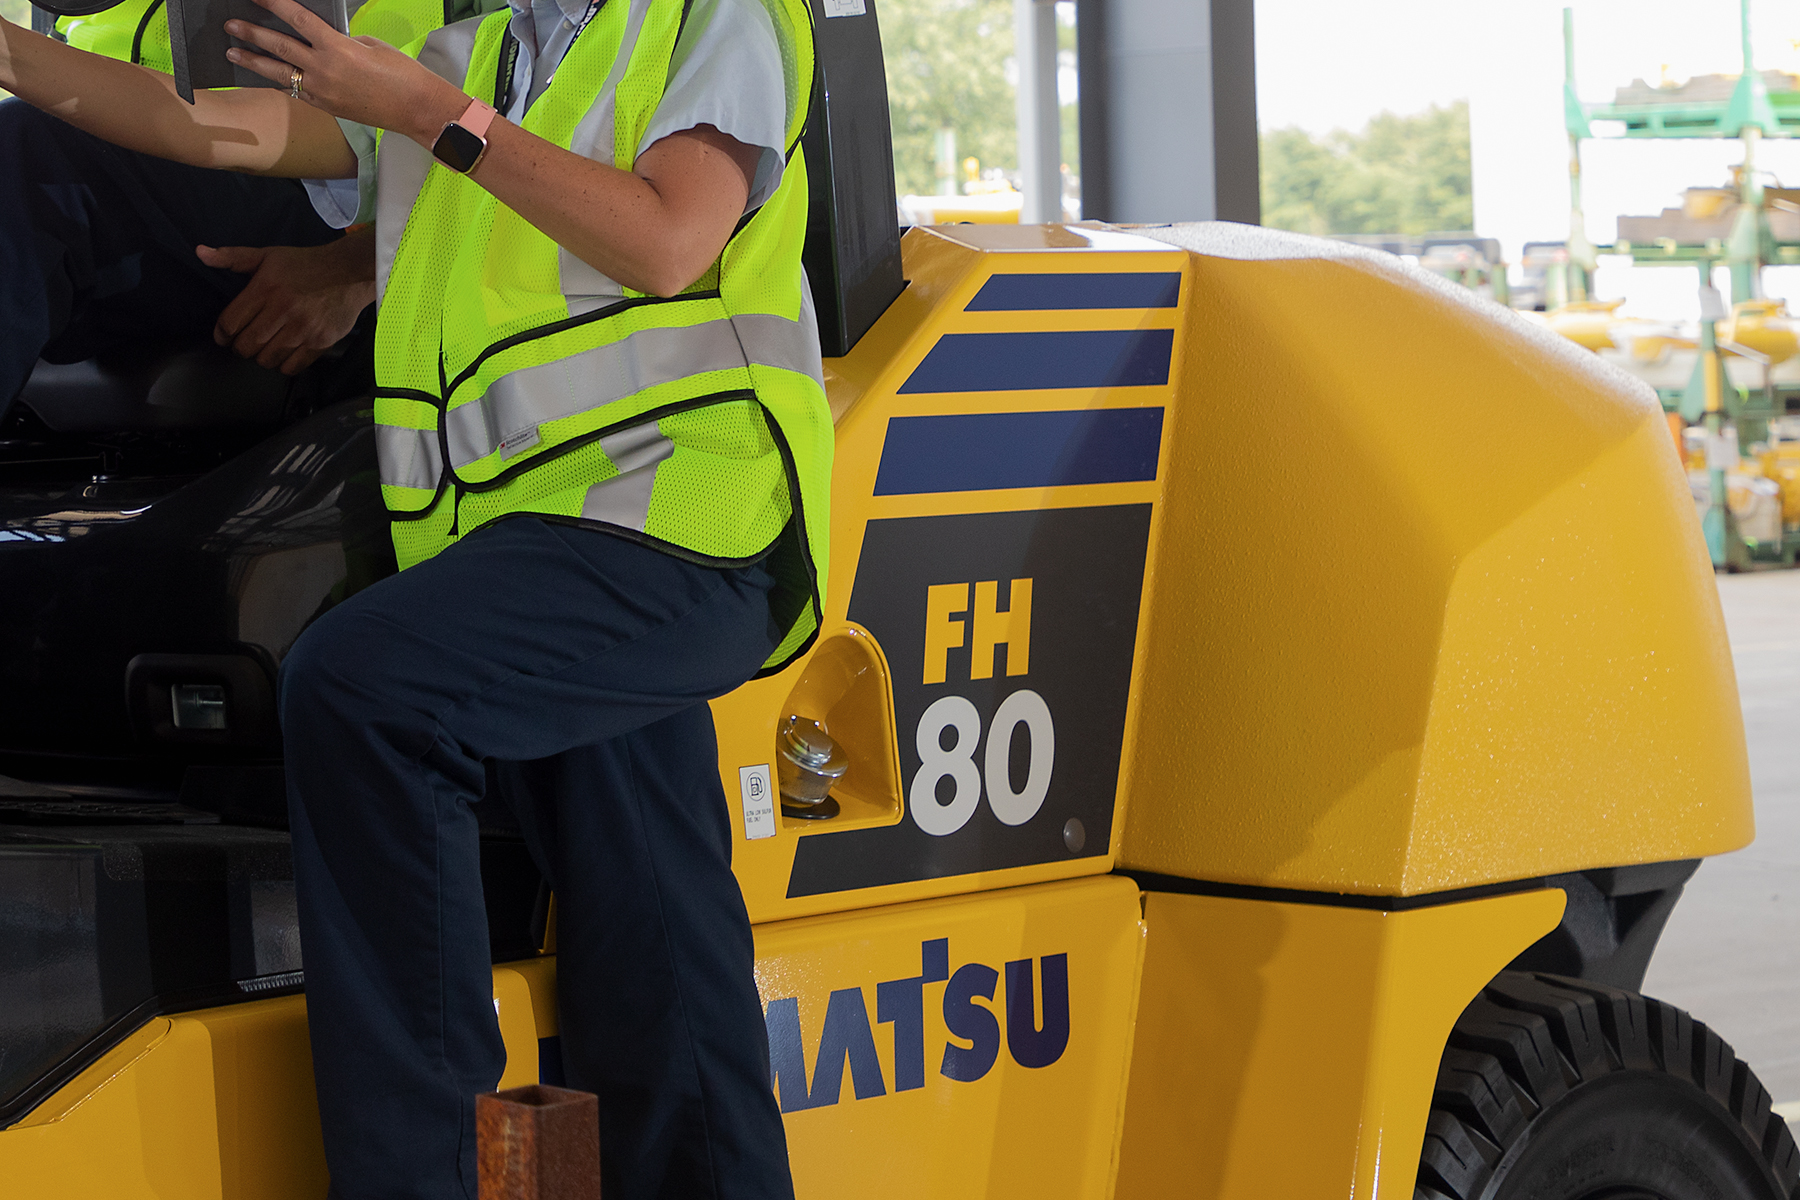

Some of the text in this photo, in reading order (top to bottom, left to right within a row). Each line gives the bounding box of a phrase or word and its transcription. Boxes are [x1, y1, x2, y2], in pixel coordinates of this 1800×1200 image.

[922, 577, 1033, 685] FH
[909, 688, 1056, 837] 80
[764, 937, 1070, 1114] MATSU
